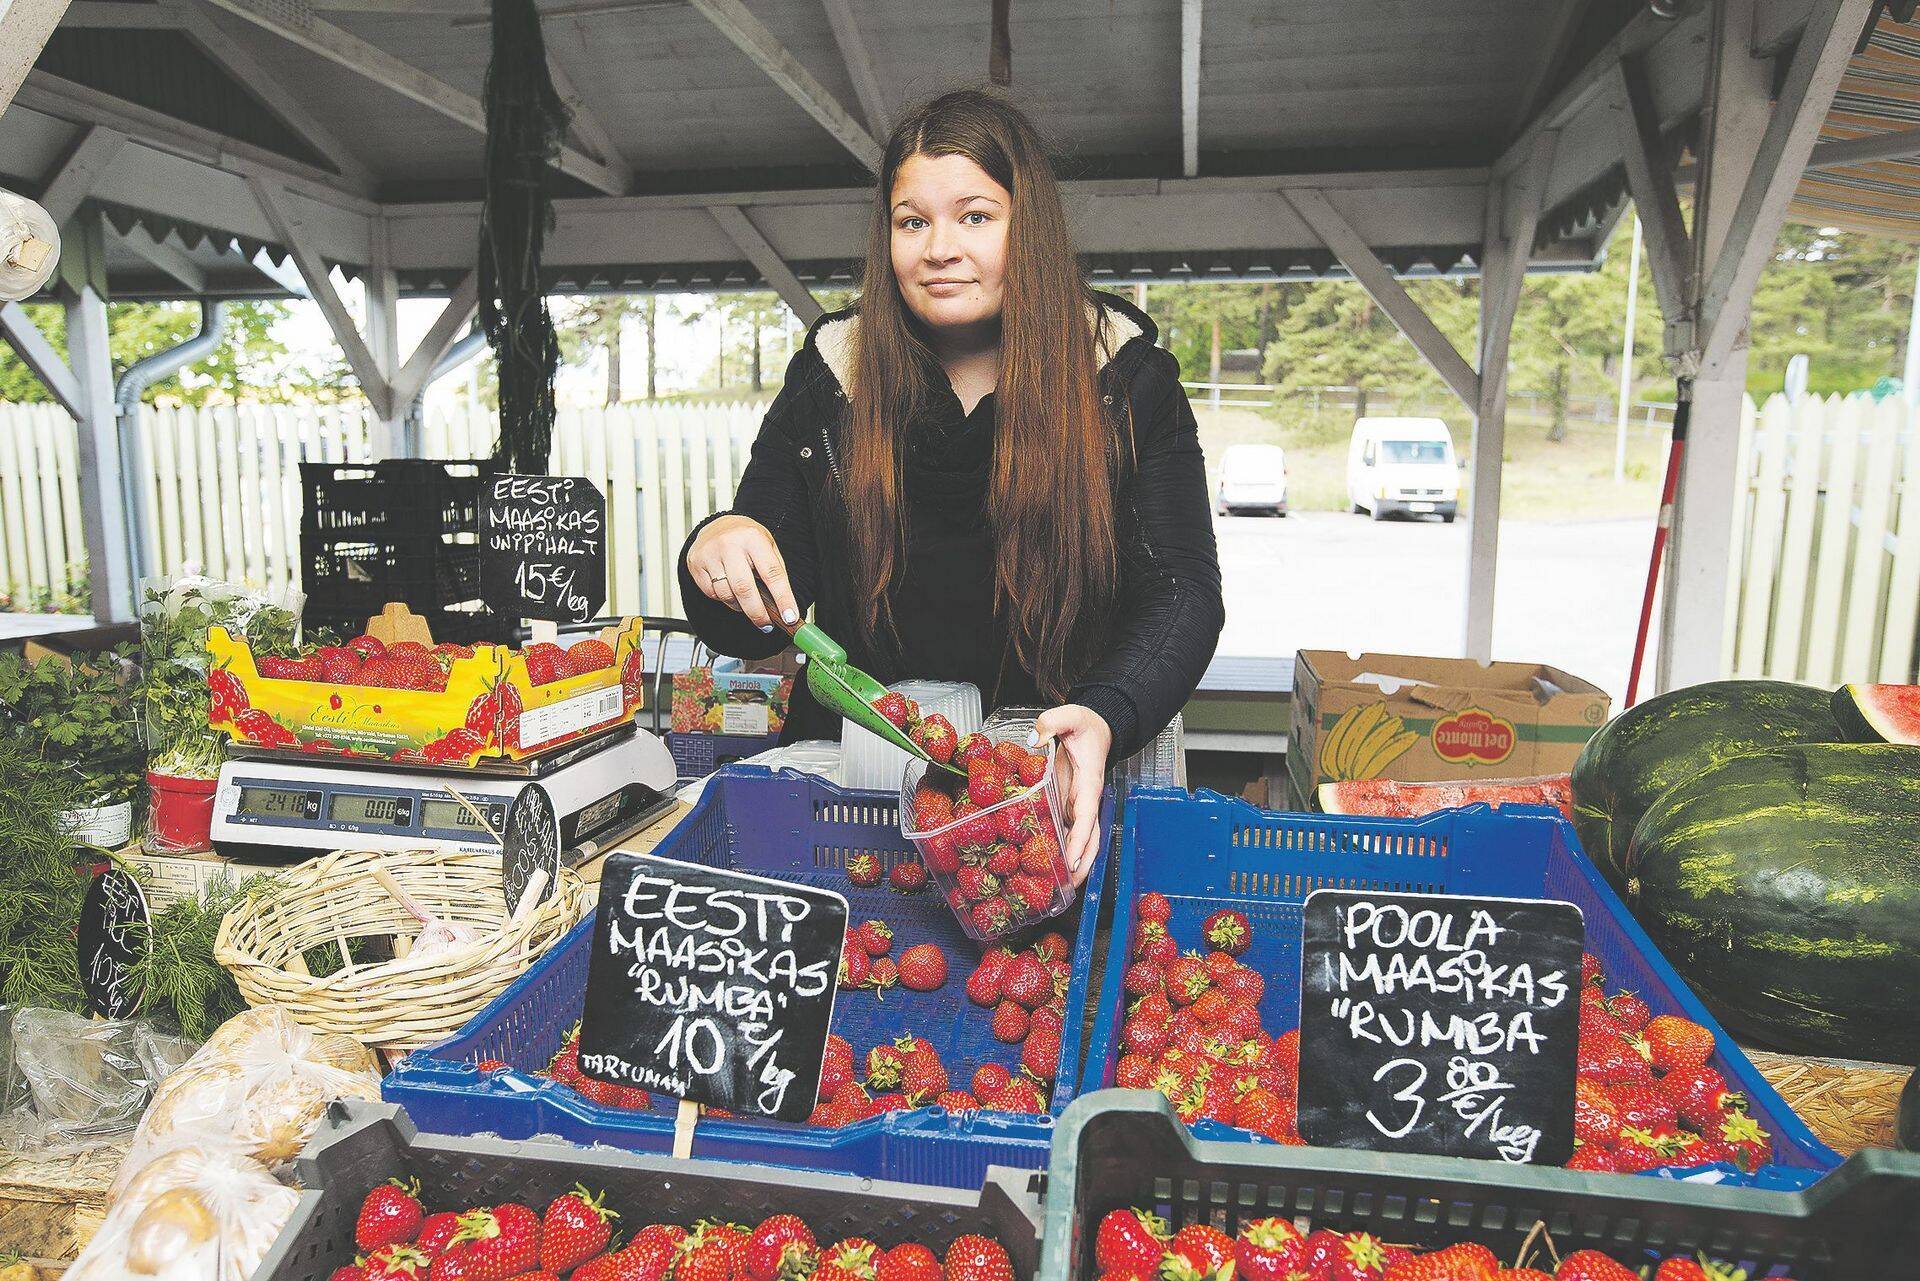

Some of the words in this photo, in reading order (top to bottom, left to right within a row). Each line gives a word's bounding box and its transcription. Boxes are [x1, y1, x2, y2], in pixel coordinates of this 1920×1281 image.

[1437, 730, 1483, 748] Monte
[1484, 733, 1508, 749] Del
[306, 800, 318, 812] kg
[491, 812, 502, 826] €
[1343, 901, 1506, 952] POOLA
